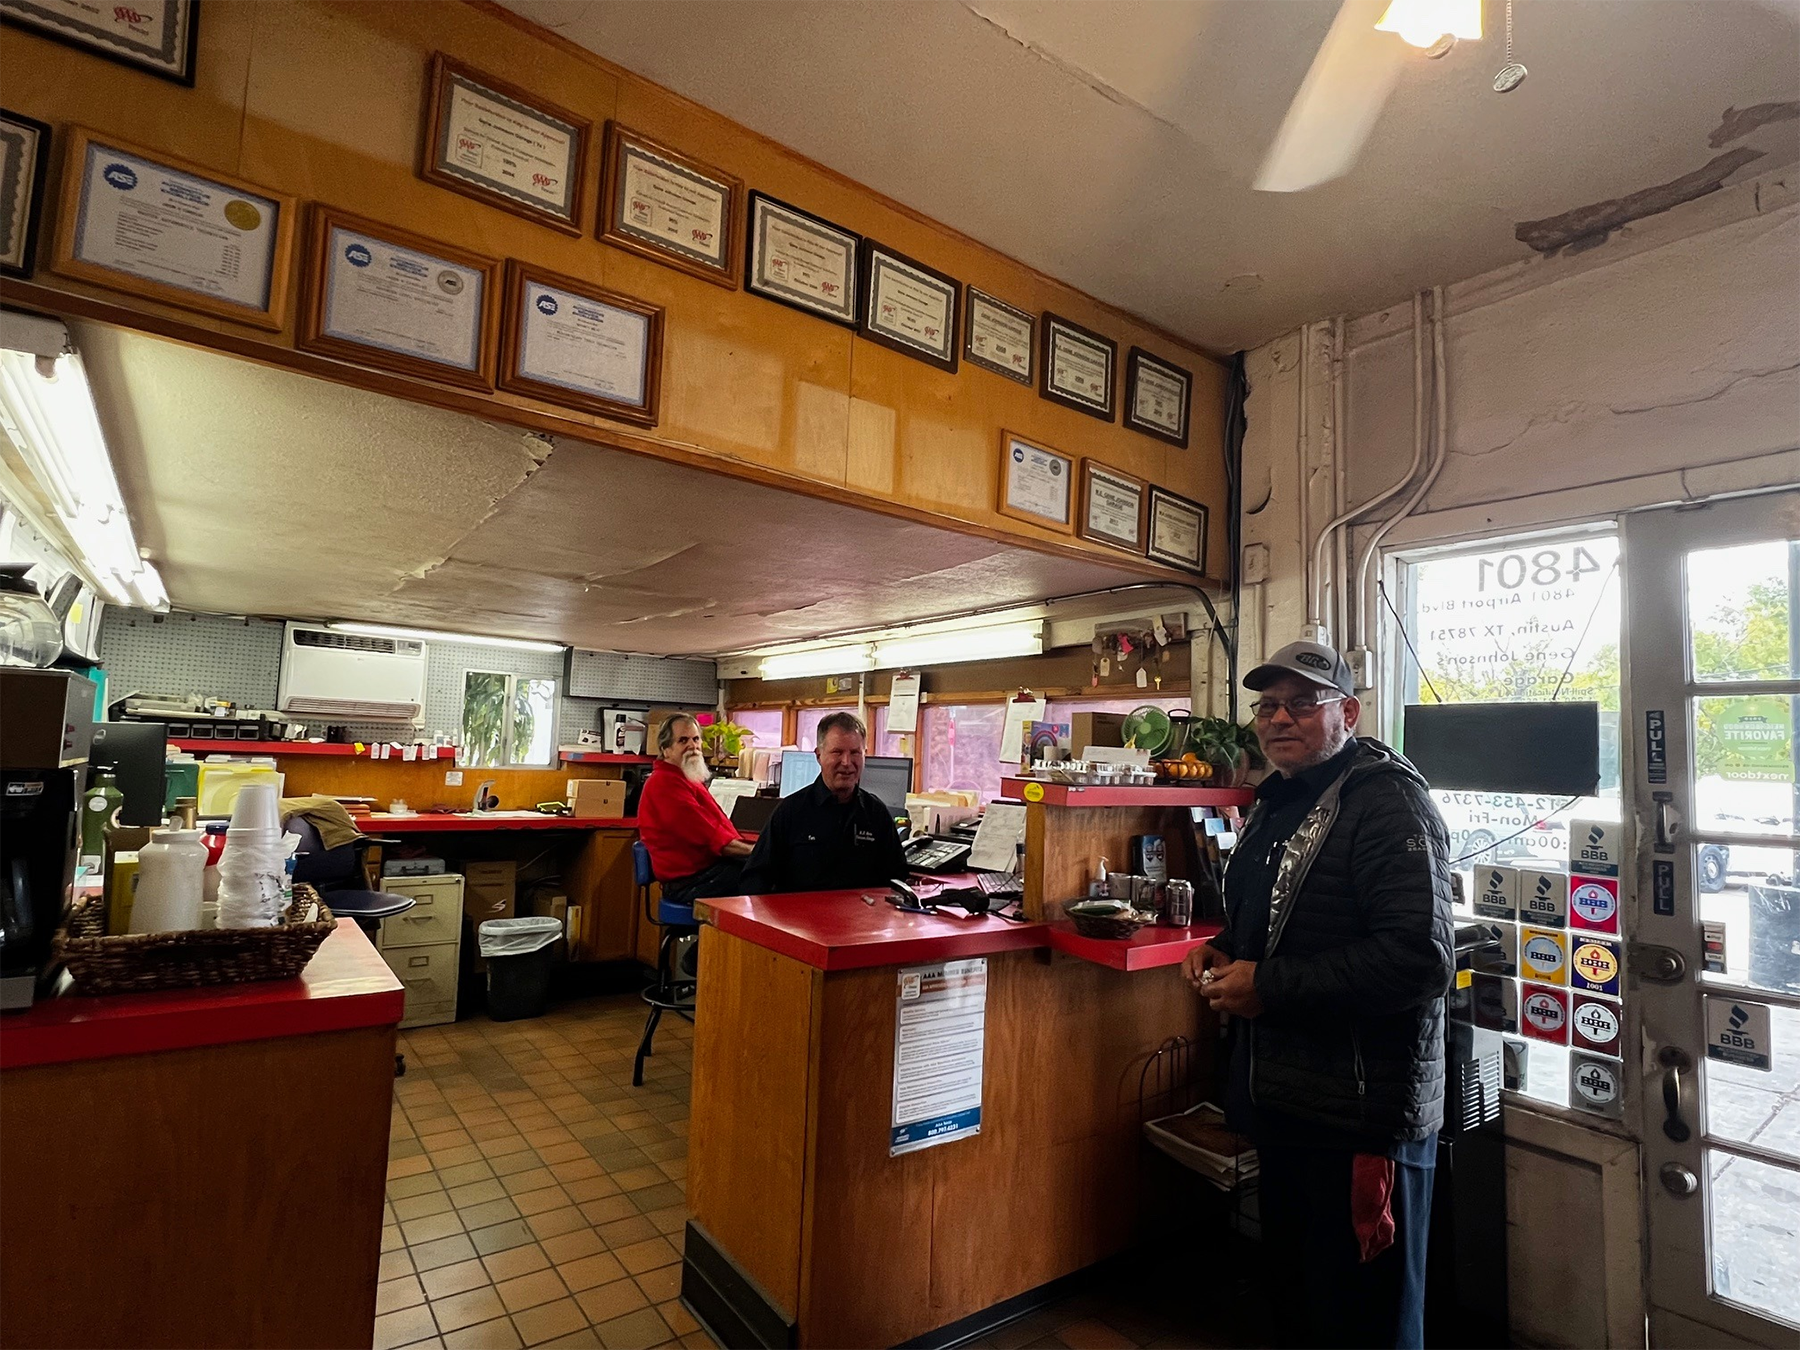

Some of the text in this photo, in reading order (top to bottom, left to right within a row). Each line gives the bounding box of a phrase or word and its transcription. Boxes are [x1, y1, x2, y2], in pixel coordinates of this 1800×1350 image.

[108, 171, 134, 186] ASE
[347, 250, 369, 263] ASE
[538, 301, 555, 311] ASE
[1649, 718, 1663, 762] PULL
[1581, 850, 1608, 861] BBB
[1657, 864, 1670, 910] PULL
[1483, 894, 1506, 905] BBB
[1530, 900, 1555, 912] BBB
[1579, 897, 1608, 908] BBB
[1530, 952, 1556, 963] BBB
[1581, 958, 1609, 970] BBB
[1531, 1006, 1558, 1019] BBB
[1581, 1016, 1610, 1030] BBB
[1720, 1033, 1755, 1050] BBB
[1581, 1075, 1610, 1090] BBB
